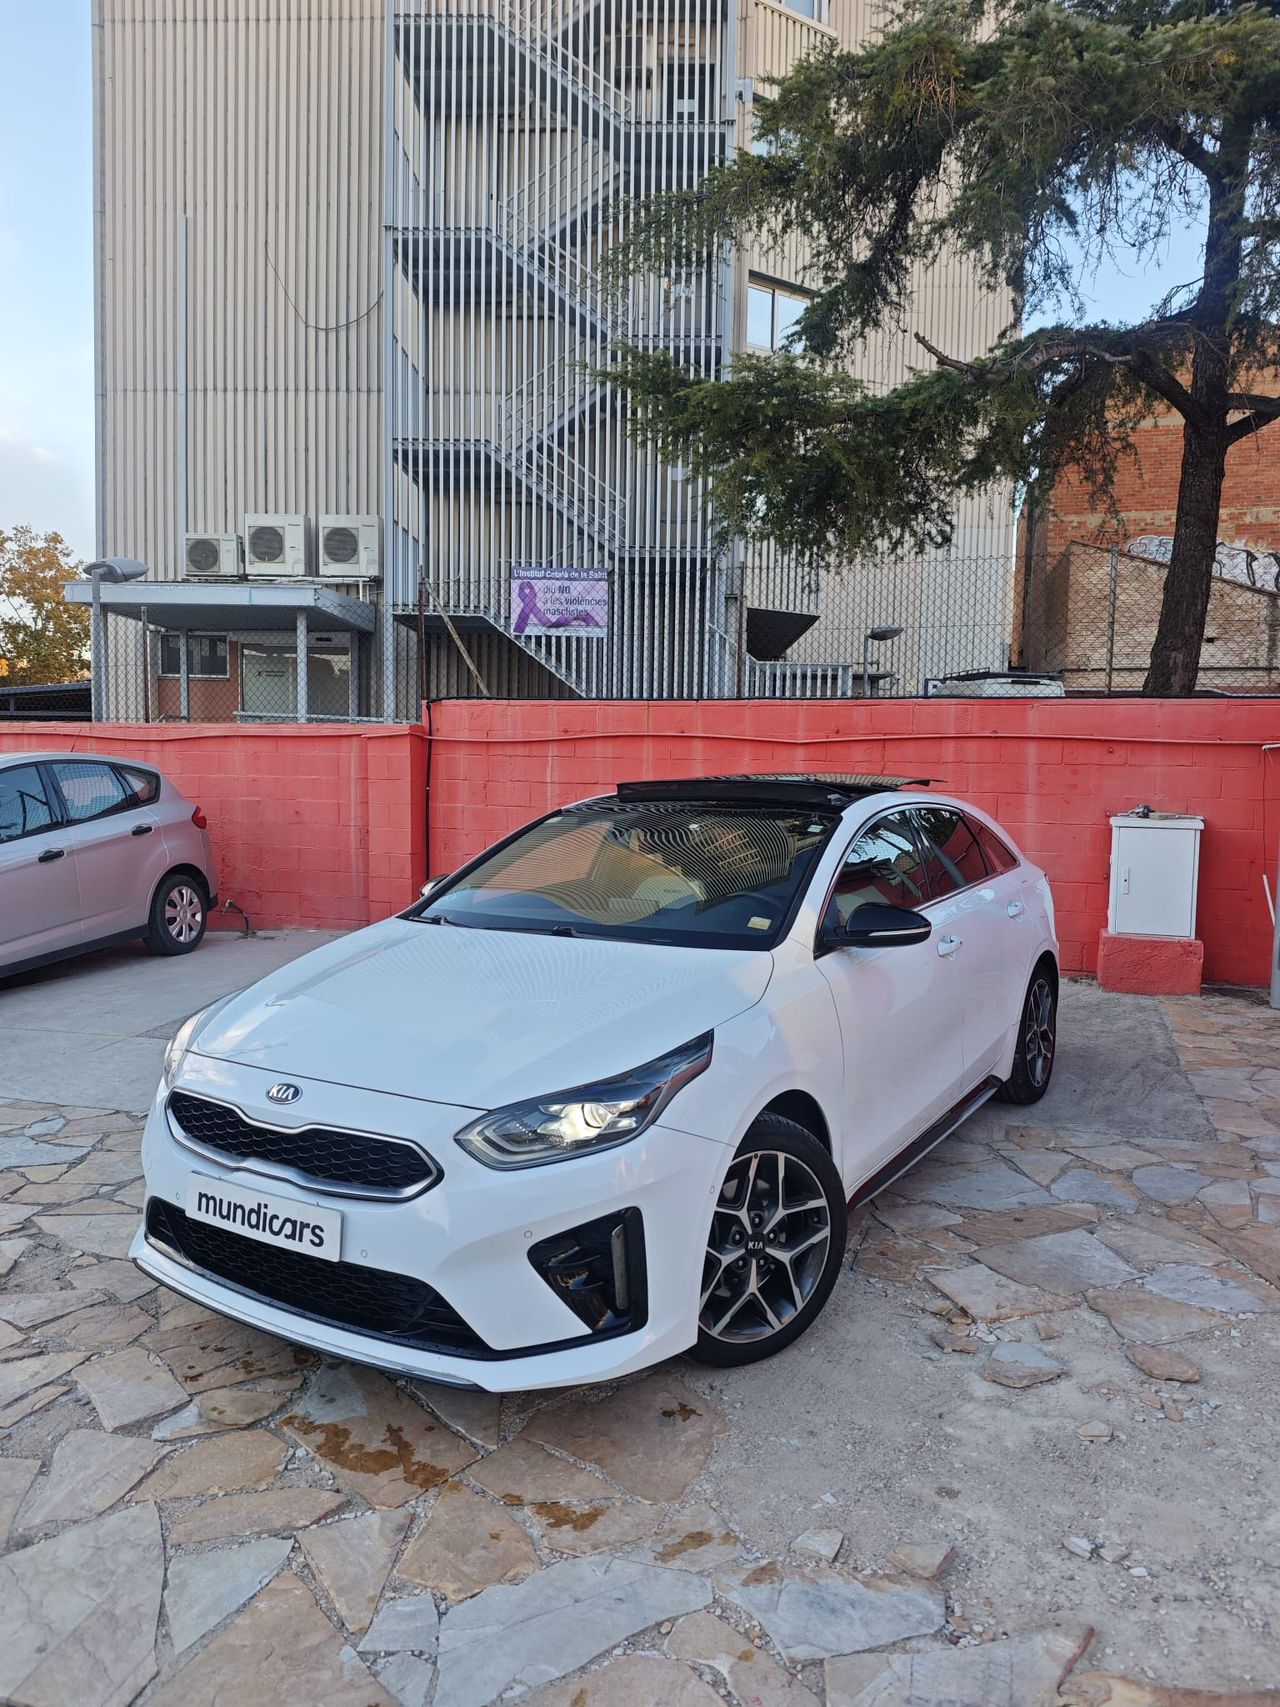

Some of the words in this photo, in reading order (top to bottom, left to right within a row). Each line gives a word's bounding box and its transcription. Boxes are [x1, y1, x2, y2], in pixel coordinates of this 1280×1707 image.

[570, 570, 579, 578] de
[558, 585, 571, 594] NO
[269, 1084, 295, 1100] KIA
[197, 1191, 325, 1248] mundicars
[747, 1241, 763, 1249] KIA
